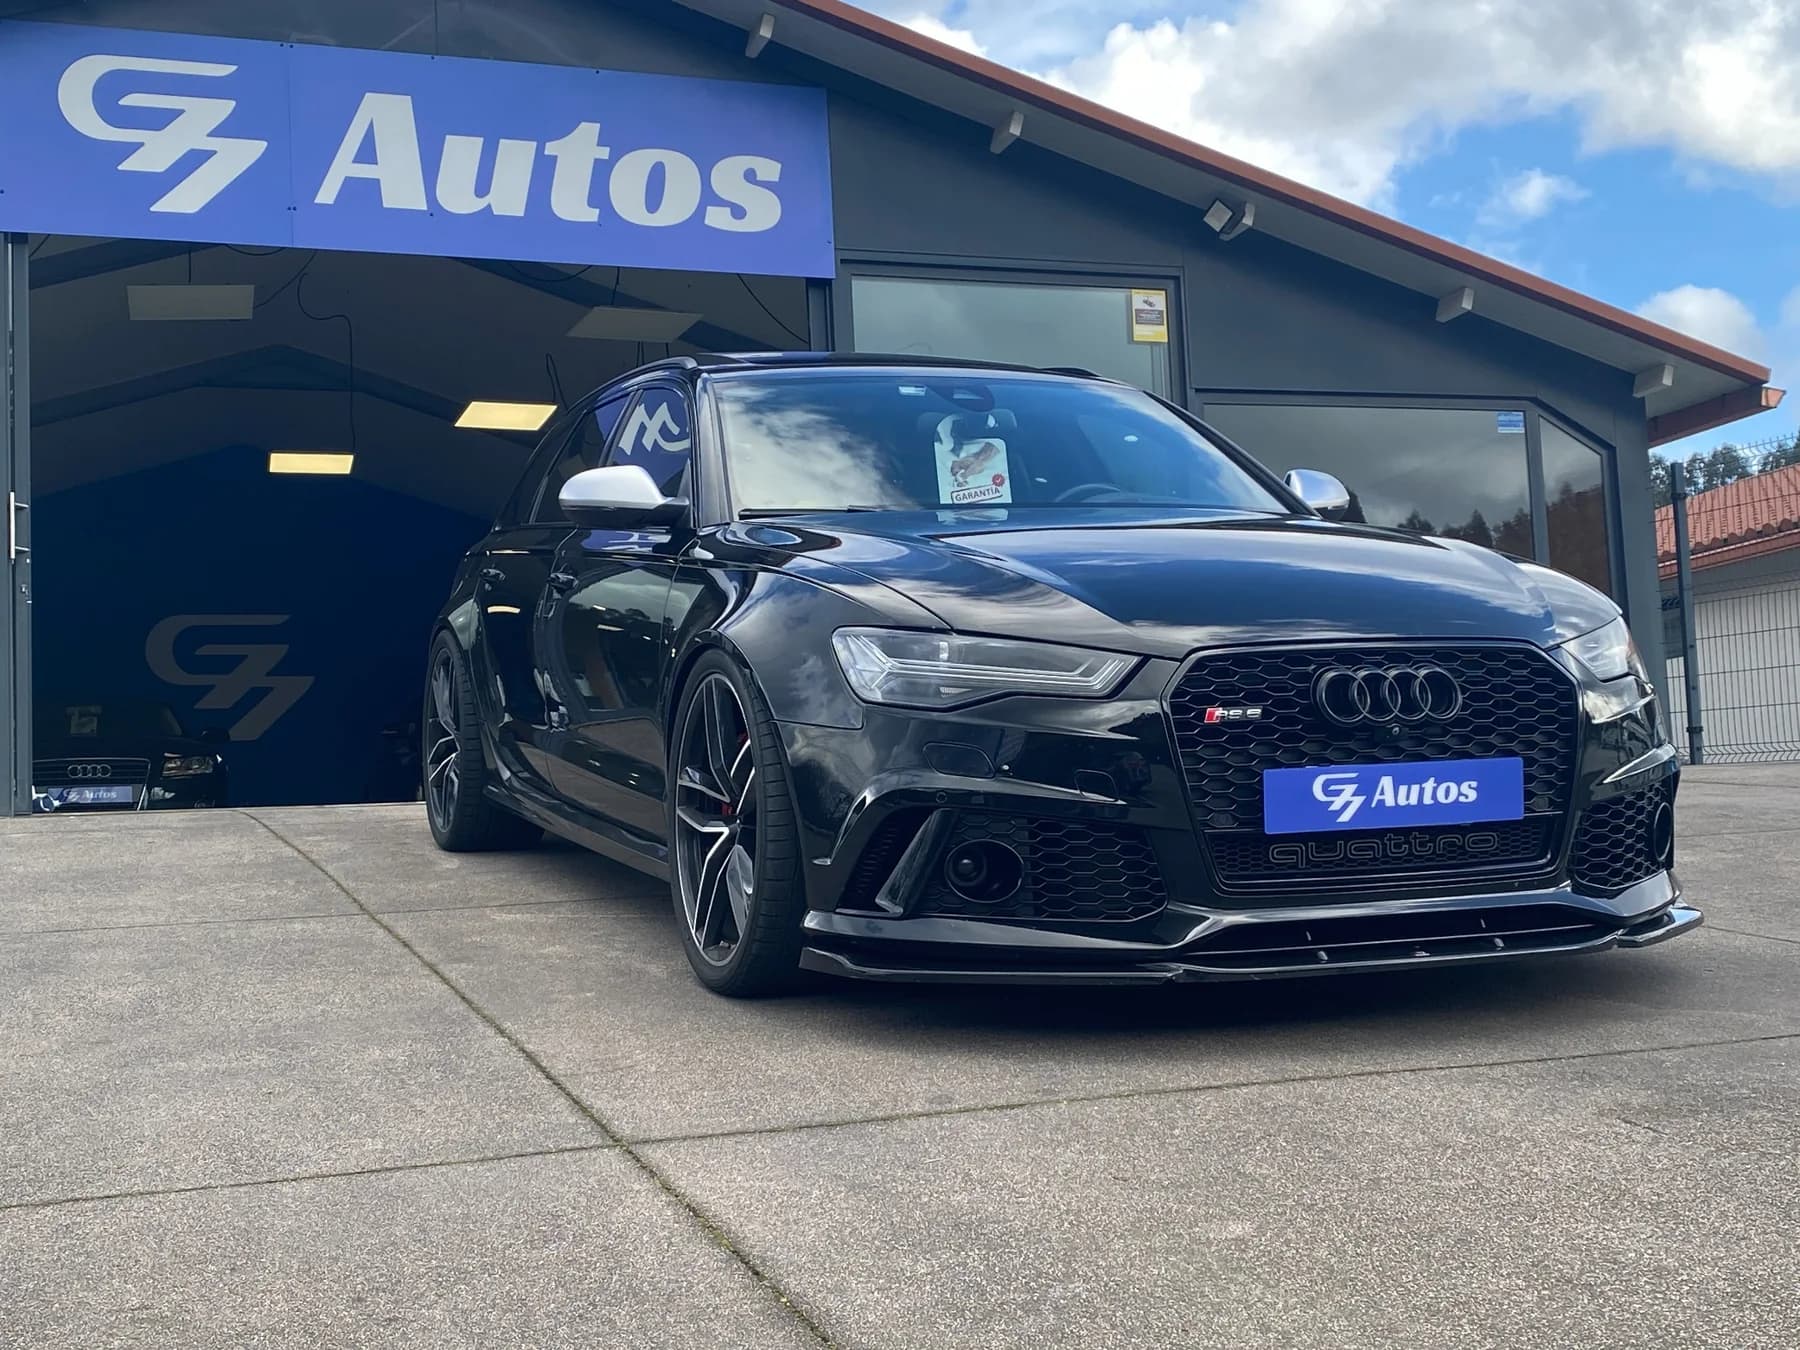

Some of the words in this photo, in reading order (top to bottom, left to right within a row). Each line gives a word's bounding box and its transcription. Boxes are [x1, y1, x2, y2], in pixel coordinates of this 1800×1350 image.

[313, 92, 783, 233] Autos
[84, 790, 118, 799] Autos
[1371, 775, 1478, 809] Autos
[1268, 830, 1499, 868] quattro
